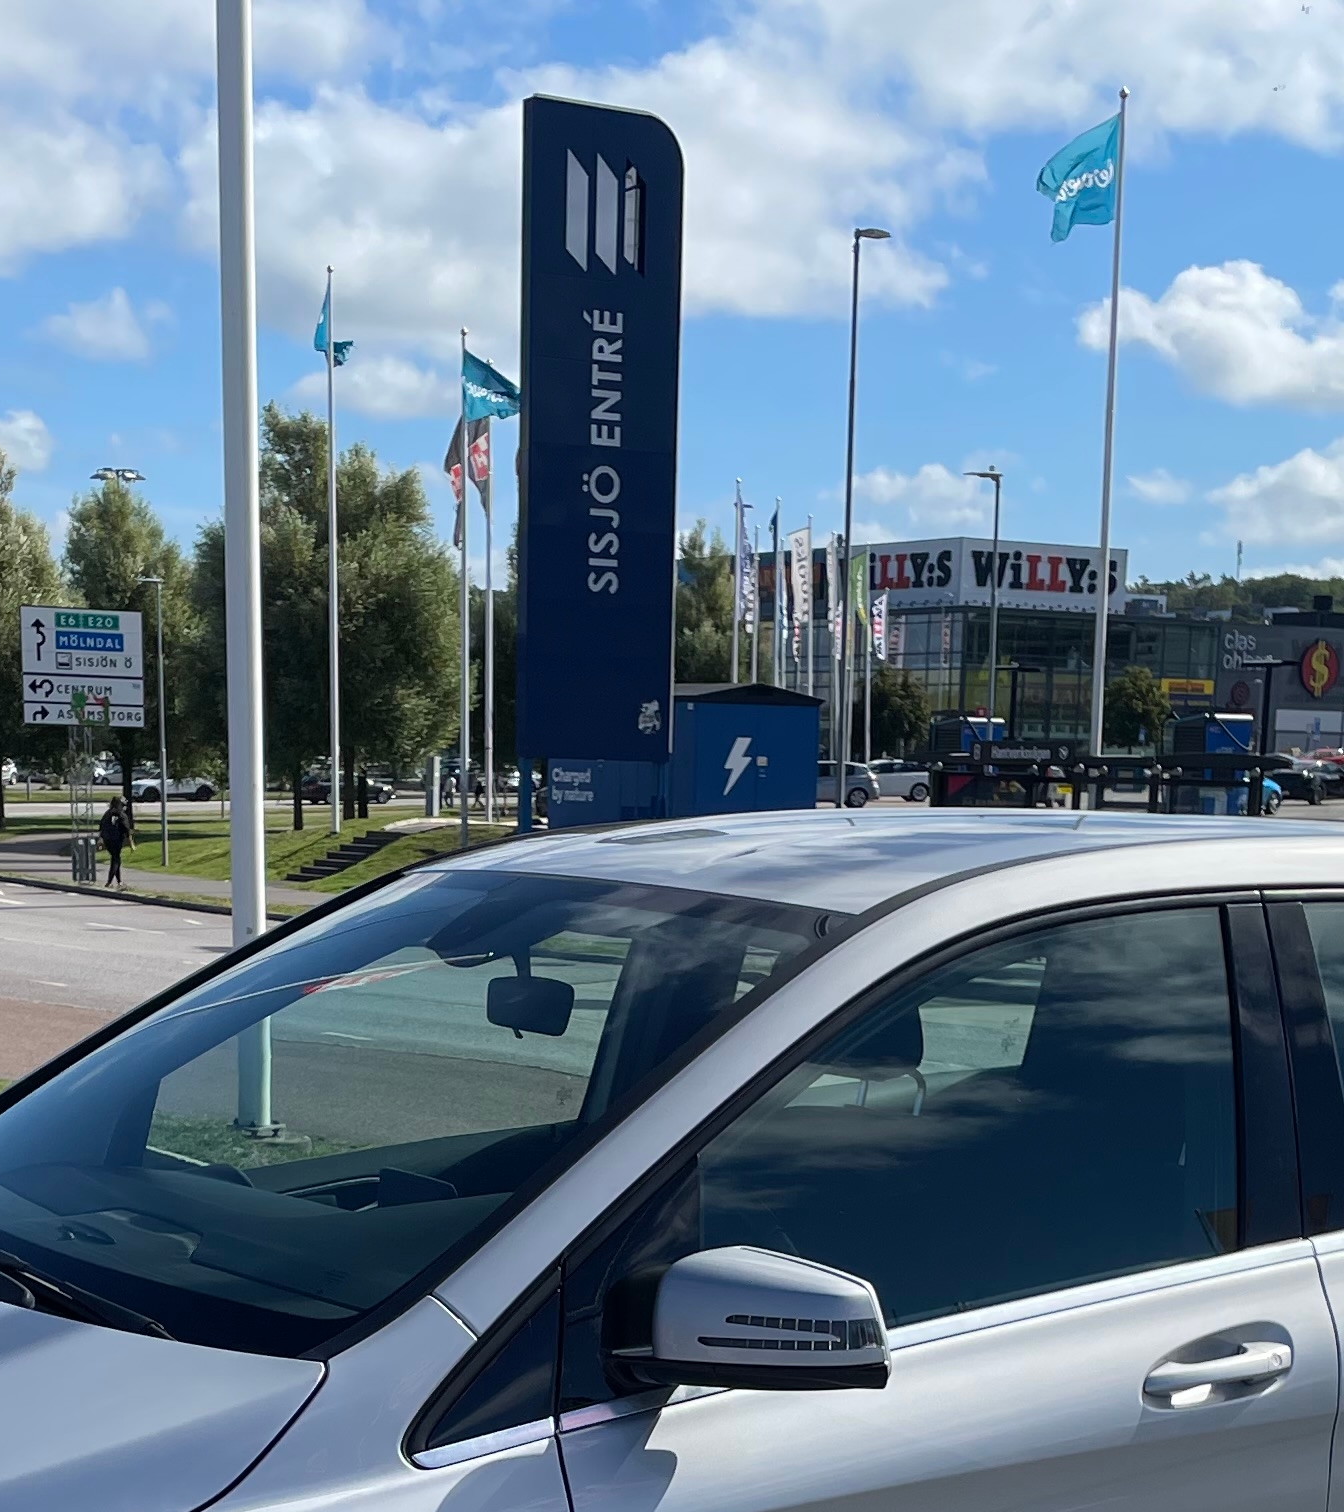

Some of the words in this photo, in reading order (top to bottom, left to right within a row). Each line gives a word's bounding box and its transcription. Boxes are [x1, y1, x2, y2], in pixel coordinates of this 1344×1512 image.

[582, 309, 624, 448] ENTRÉ
[582, 465, 621, 595] SISJÖ
[60, 615, 76, 626] E6
[87, 617, 114, 628] E20
[59, 634, 122, 649] MÖLNDAL
[1224, 628, 1257, 651] clas
[75, 655, 118, 669] SISJÖN
[124, 656, 133, 669] Ö
[56, 684, 113, 696] CENTRUM
[111, 711, 142, 722] TORG
[551, 766, 592, 787] Charged
[551, 783, 563, 805] by
[564, 787, 594, 802] nature
